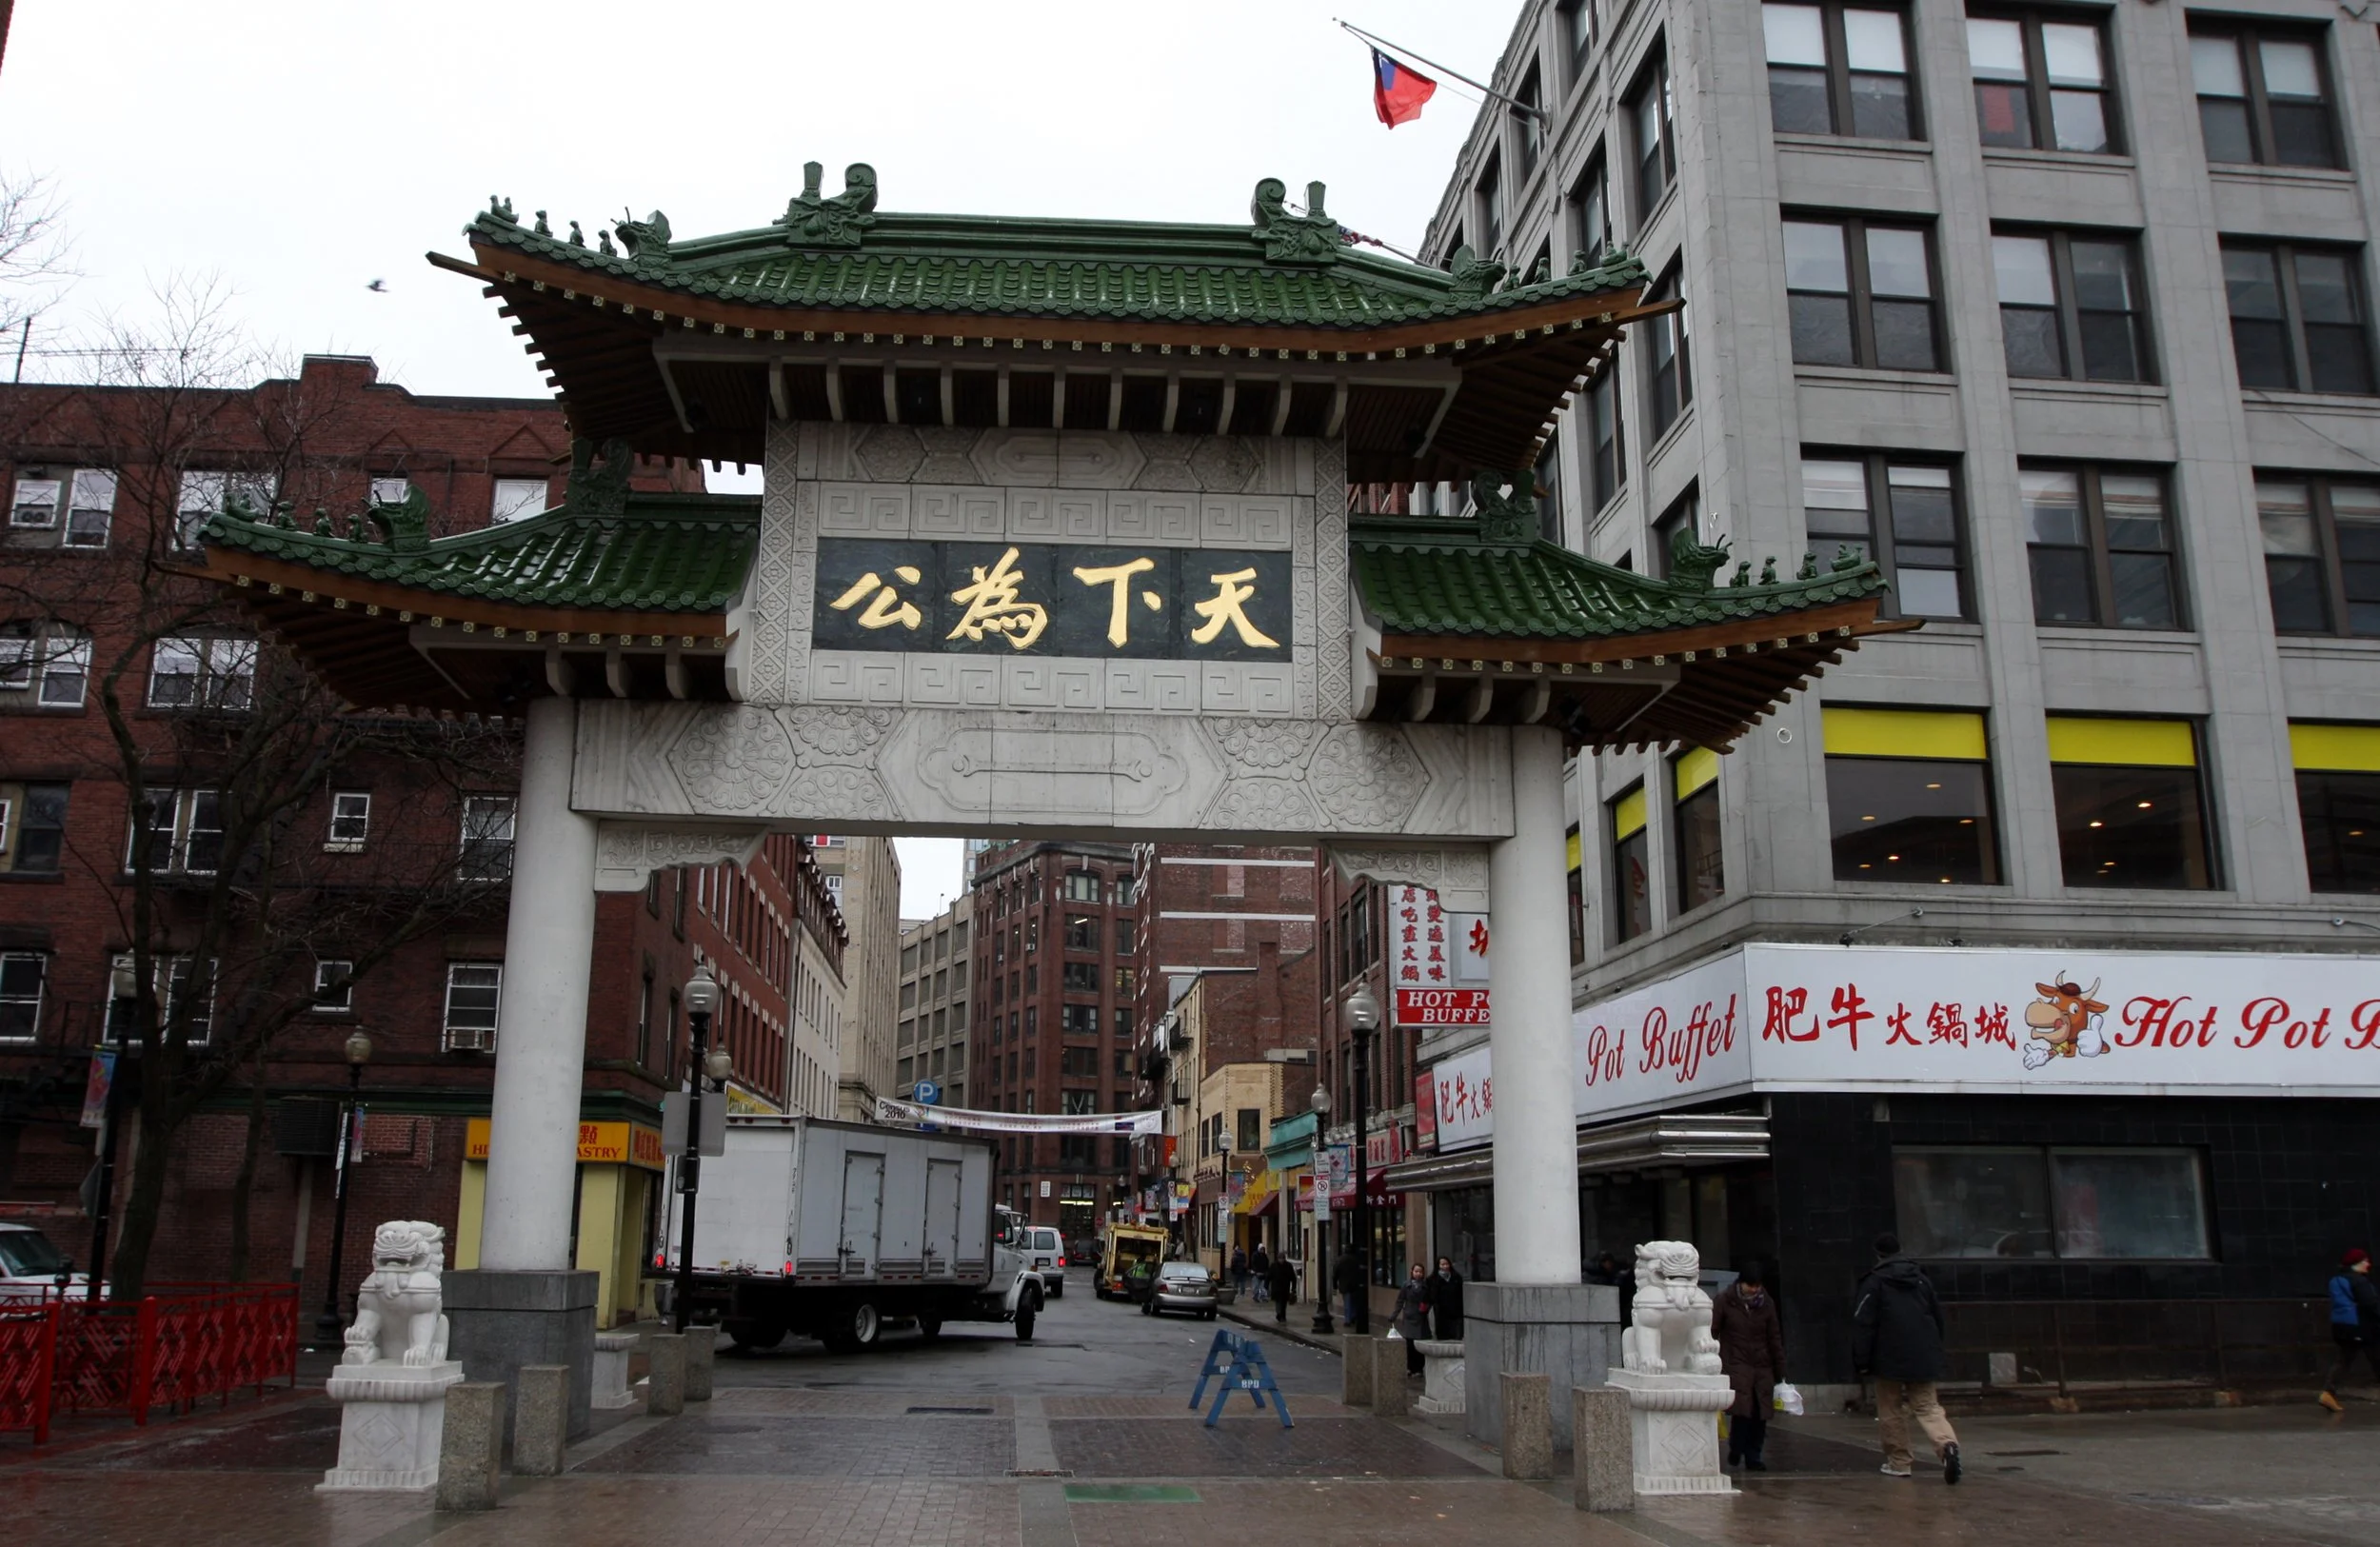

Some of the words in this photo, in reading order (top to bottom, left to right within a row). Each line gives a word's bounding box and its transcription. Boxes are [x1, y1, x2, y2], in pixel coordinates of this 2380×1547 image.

[1407, 991, 1458, 1007] HOT
[1421, 1008, 1490, 1022] BUFFE
[1761, 982, 2017, 1051] 肥牛火鍋城
[2113, 995, 2218, 1048] Hot
[2233, 996, 2331, 1049] Pot
[1585, 1024, 1625, 1087] Pot
[1638, 993, 1737, 1084] Buffet
[879, 1100, 911, 1113] Census
[884, 1108, 906, 1119] 2010
[1241, 1379, 1259, 1389] BPD
